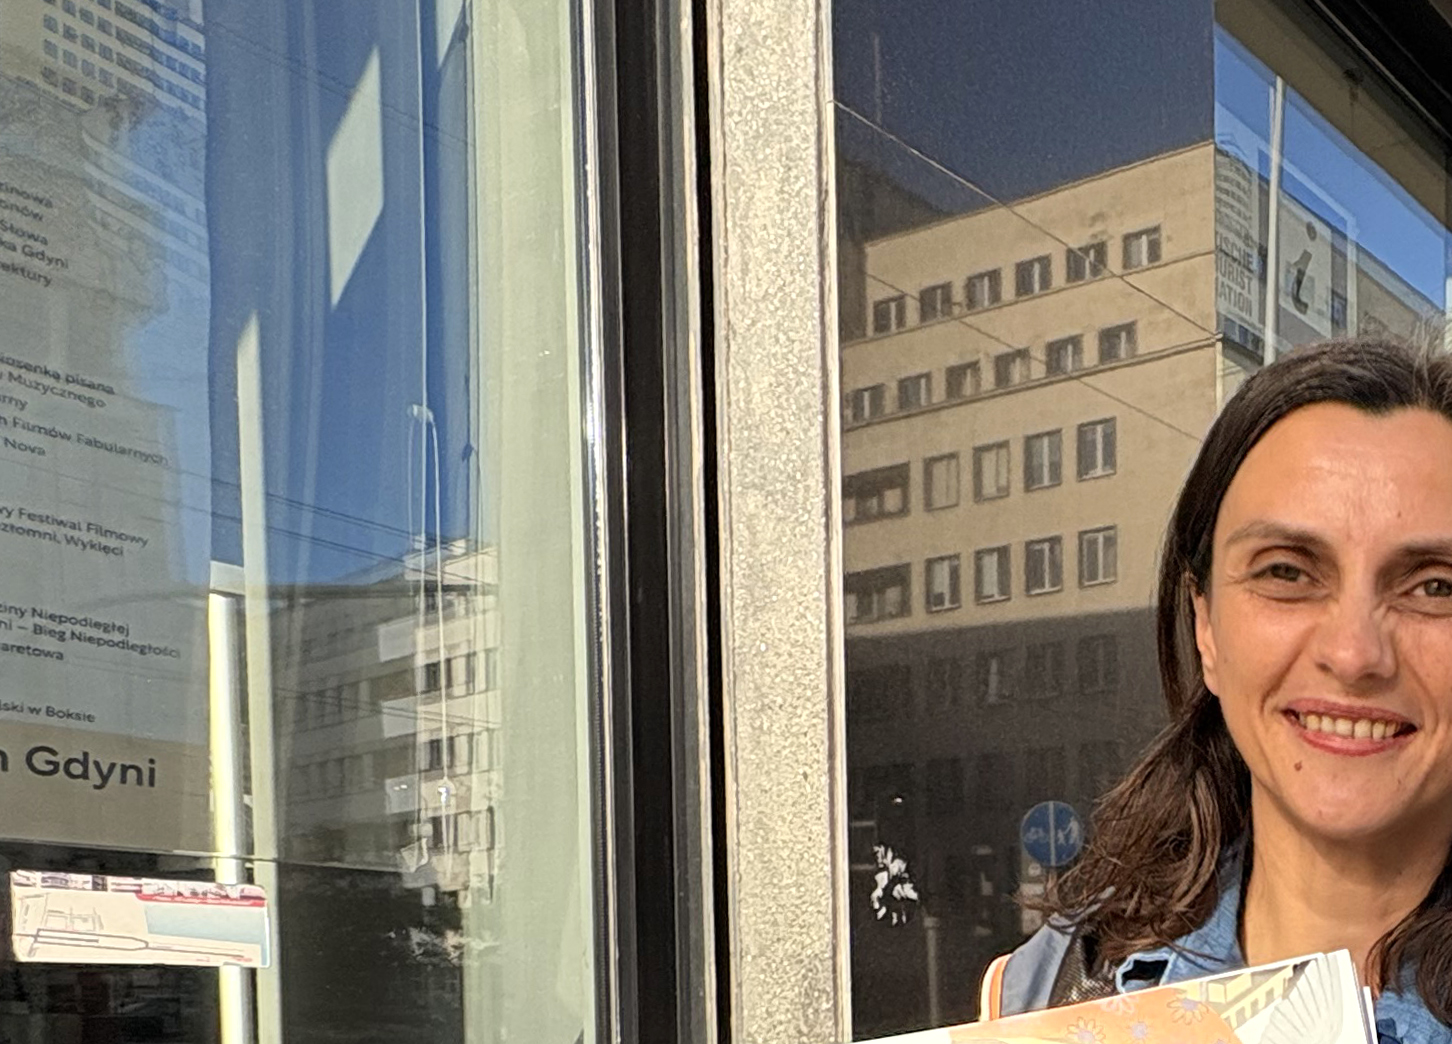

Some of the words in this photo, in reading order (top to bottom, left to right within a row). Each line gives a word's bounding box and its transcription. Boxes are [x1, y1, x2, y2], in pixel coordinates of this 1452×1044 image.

[22, 244, 69, 270] Gdyni
[8, 371, 107, 409] Muzycznego
[3, 437, 46, 457] Nova
[12, 416, 72, 442] Filmów
[76, 432, 169, 466] Fabularnych
[18, 507, 82, 532] Festiwal
[86, 522, 149, 548] Filmowy
[64, 533, 124, 557] Wyklęci
[31, 606, 130, 637] Niepodległej
[33, 622, 66, 643] Bieg
[70, 629, 181, 660] Niepodległości
[28, 705, 42, 716] w
[45, 705, 96, 723] Boksie
[25, 744, 156, 790] Gdyni
